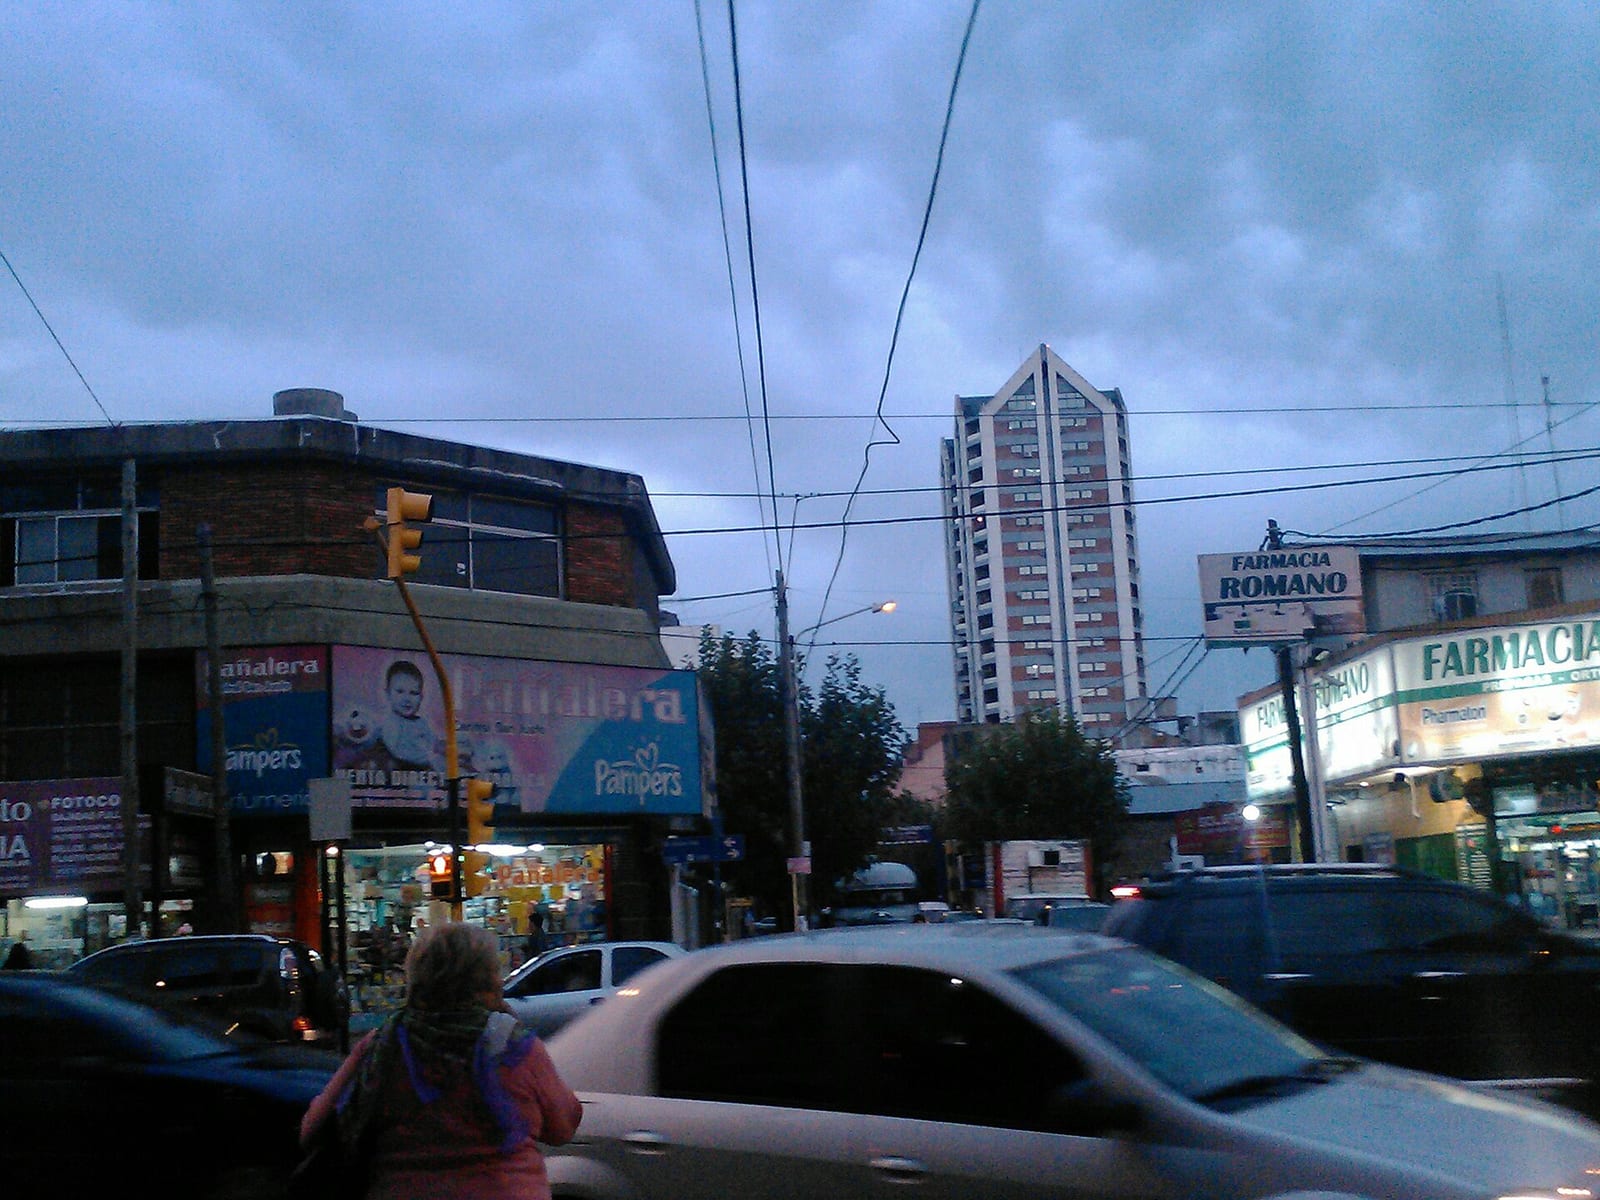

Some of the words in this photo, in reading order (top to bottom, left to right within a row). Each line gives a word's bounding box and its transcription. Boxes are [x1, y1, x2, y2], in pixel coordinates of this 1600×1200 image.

[1231, 552, 1331, 571] FARMACIA
[1220, 571, 1348, 599] ROMANO
[216, 656, 320, 677] añalera
[1570, 667, 1600, 681] ORT
[1422, 705, 1486, 725] Pharmaton
[224, 748, 303, 778] ampers
[391, 770, 447, 789] DIRECT
[594, 758, 683, 806] Pampers
